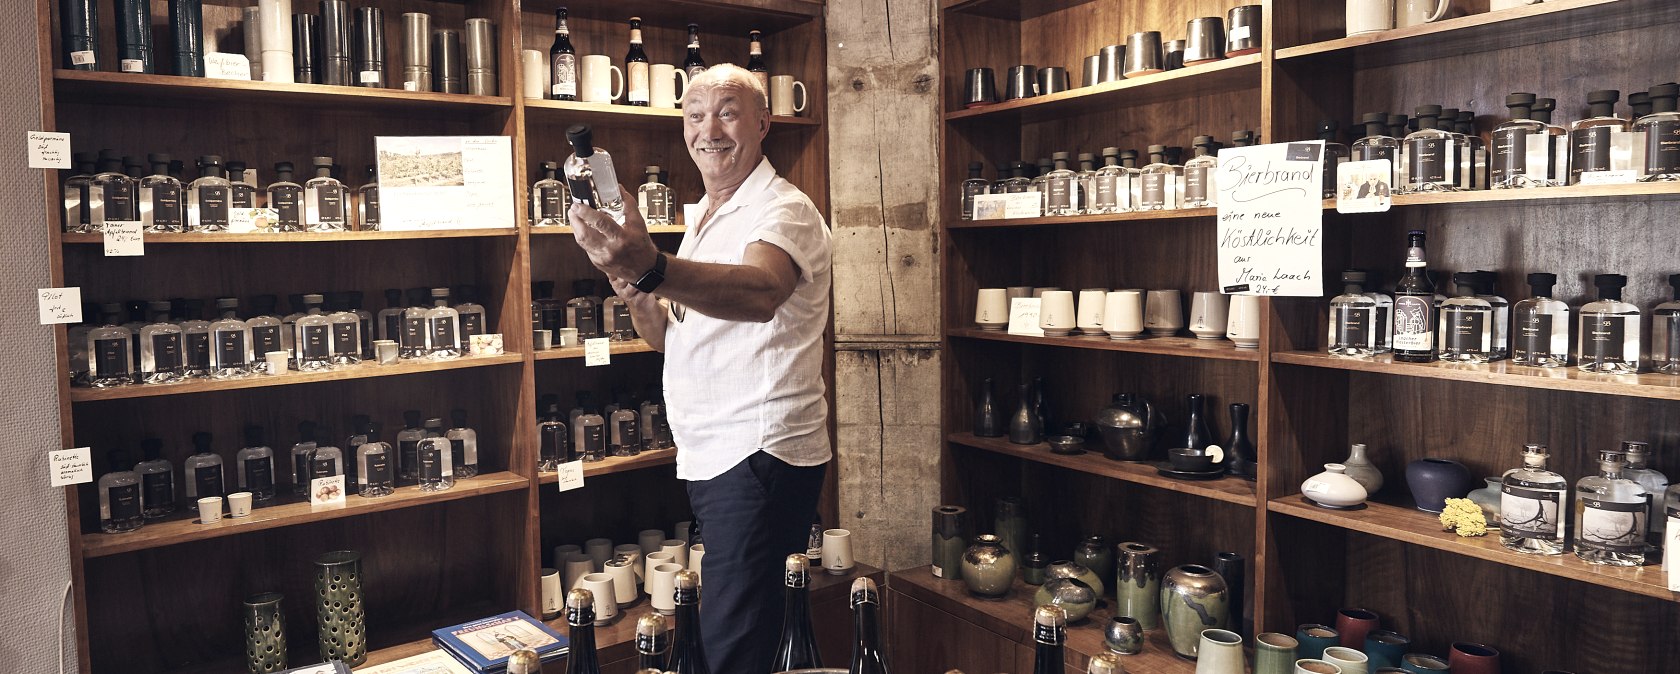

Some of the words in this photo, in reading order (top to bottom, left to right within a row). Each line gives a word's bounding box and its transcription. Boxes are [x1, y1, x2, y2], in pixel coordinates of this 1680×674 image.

[1221, 155, 1315, 191] Bierbrand
[1222, 211, 1245, 222] eine
[1253, 211, 1281, 219] neue
[1221, 227, 1319, 249] Köstlichkeit
[1233, 255, 1251, 264] aus
[1272, 267, 1311, 281] Laach
